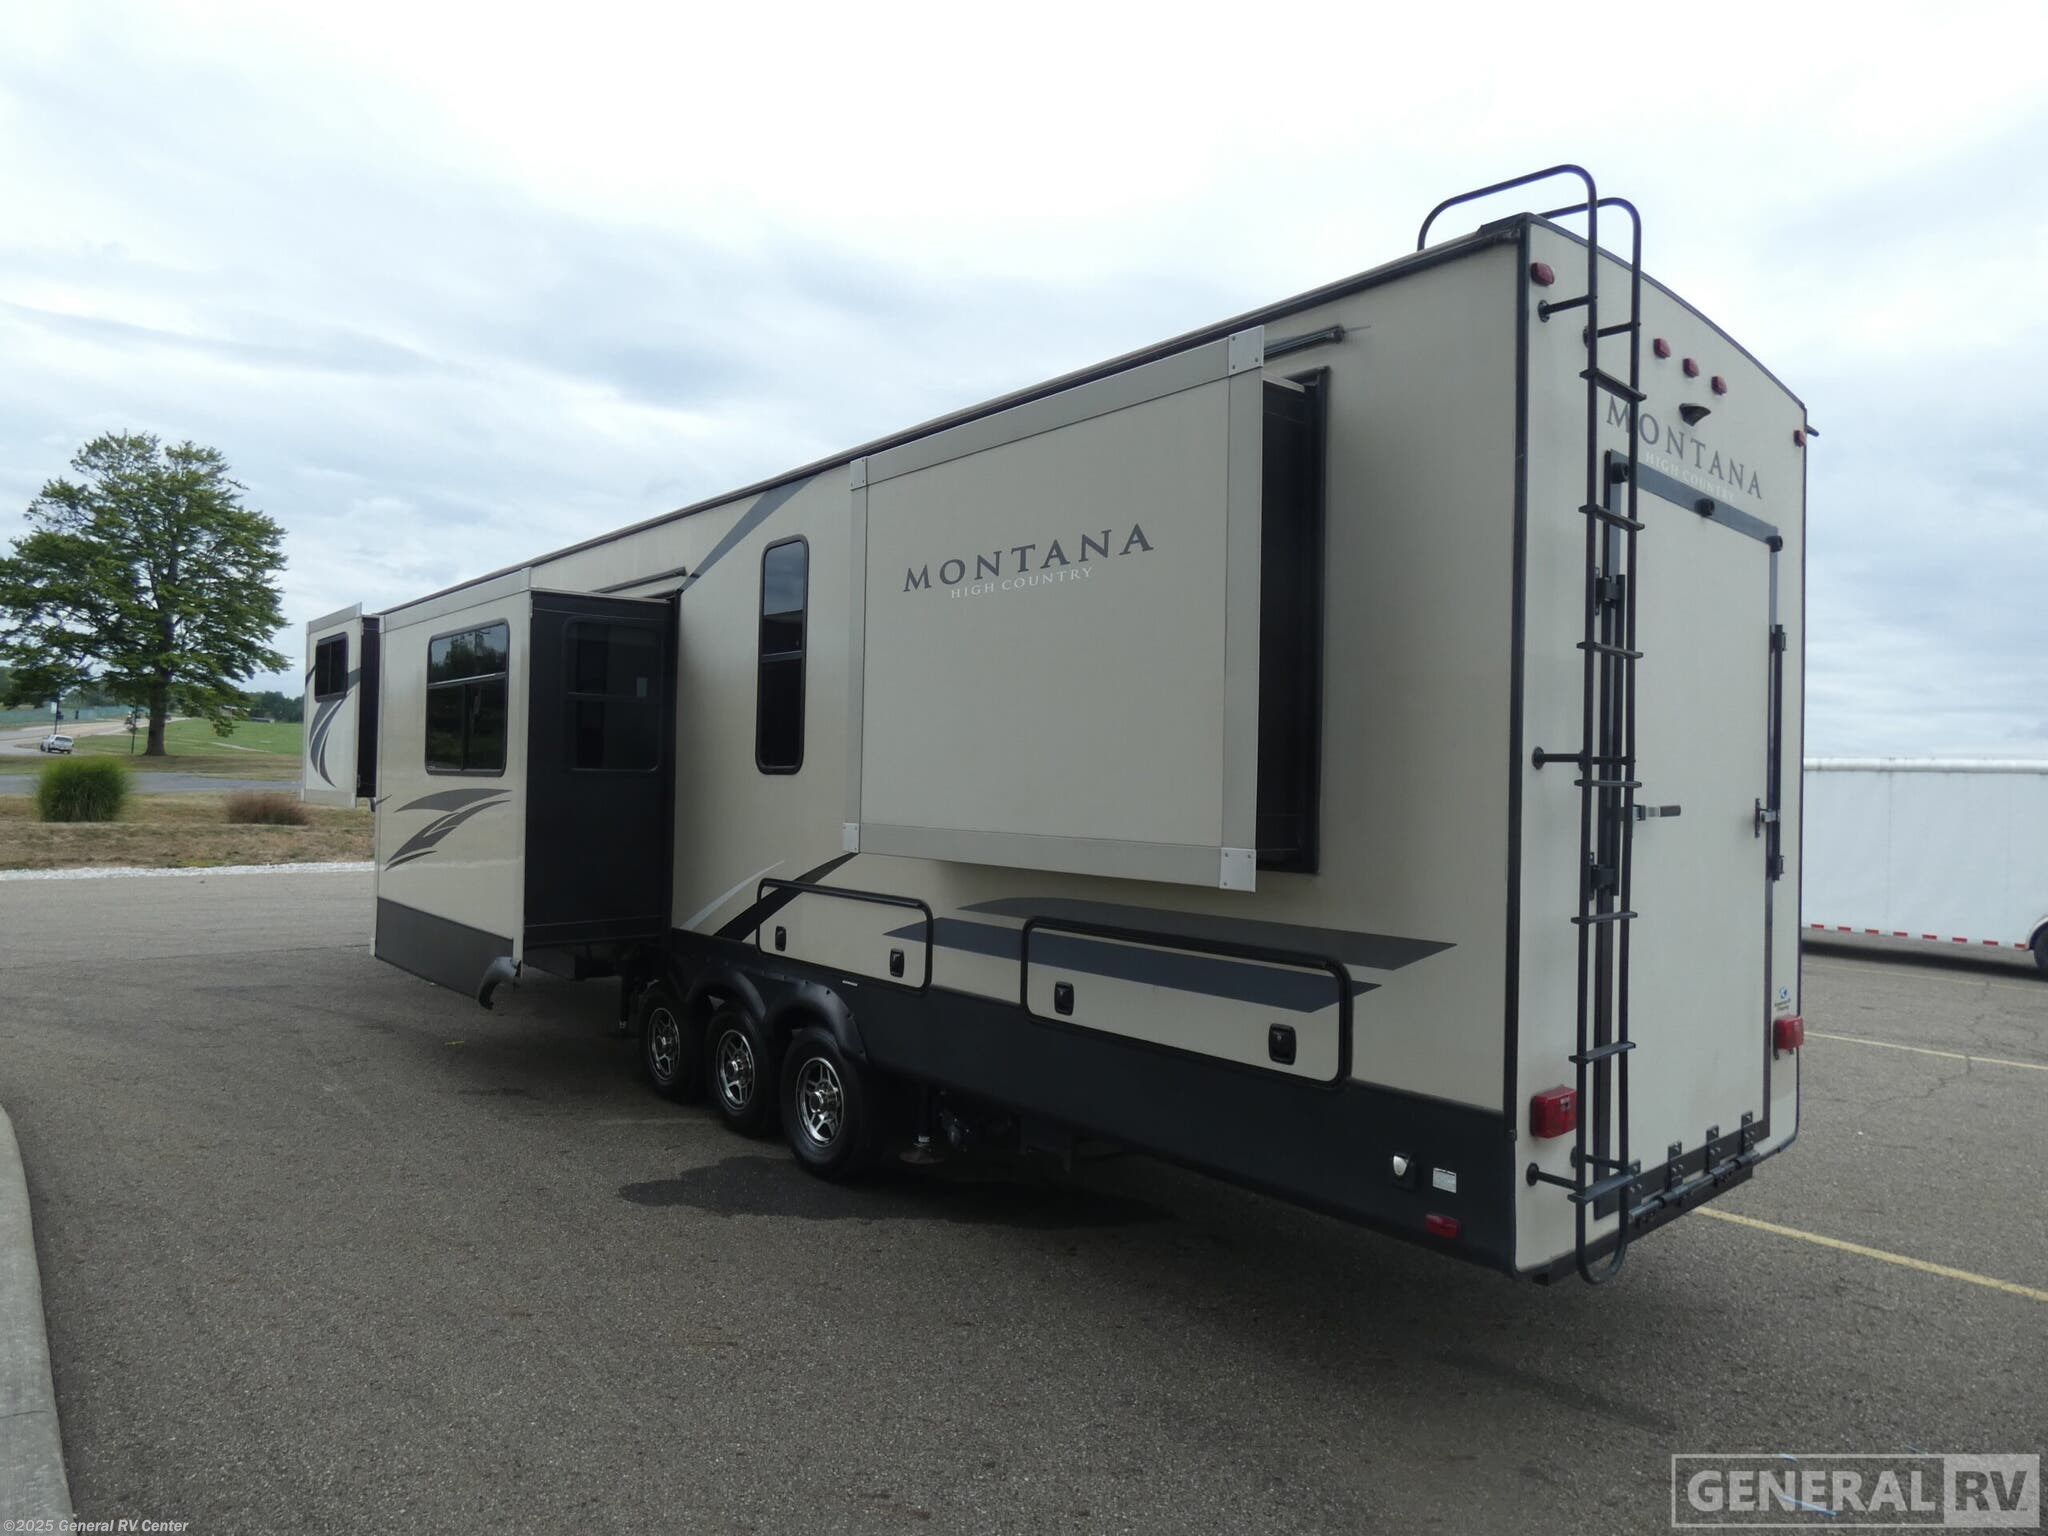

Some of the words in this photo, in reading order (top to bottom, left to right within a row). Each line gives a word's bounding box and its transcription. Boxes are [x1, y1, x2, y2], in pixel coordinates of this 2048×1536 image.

[1606, 395, 1762, 500] MONTANA
[1646, 451, 1680, 476] HIGH
[904, 523, 1154, 592] MONTANA
[951, 583, 995, 599] HIGH
[1001, 566, 1093, 591] COUNTRY
